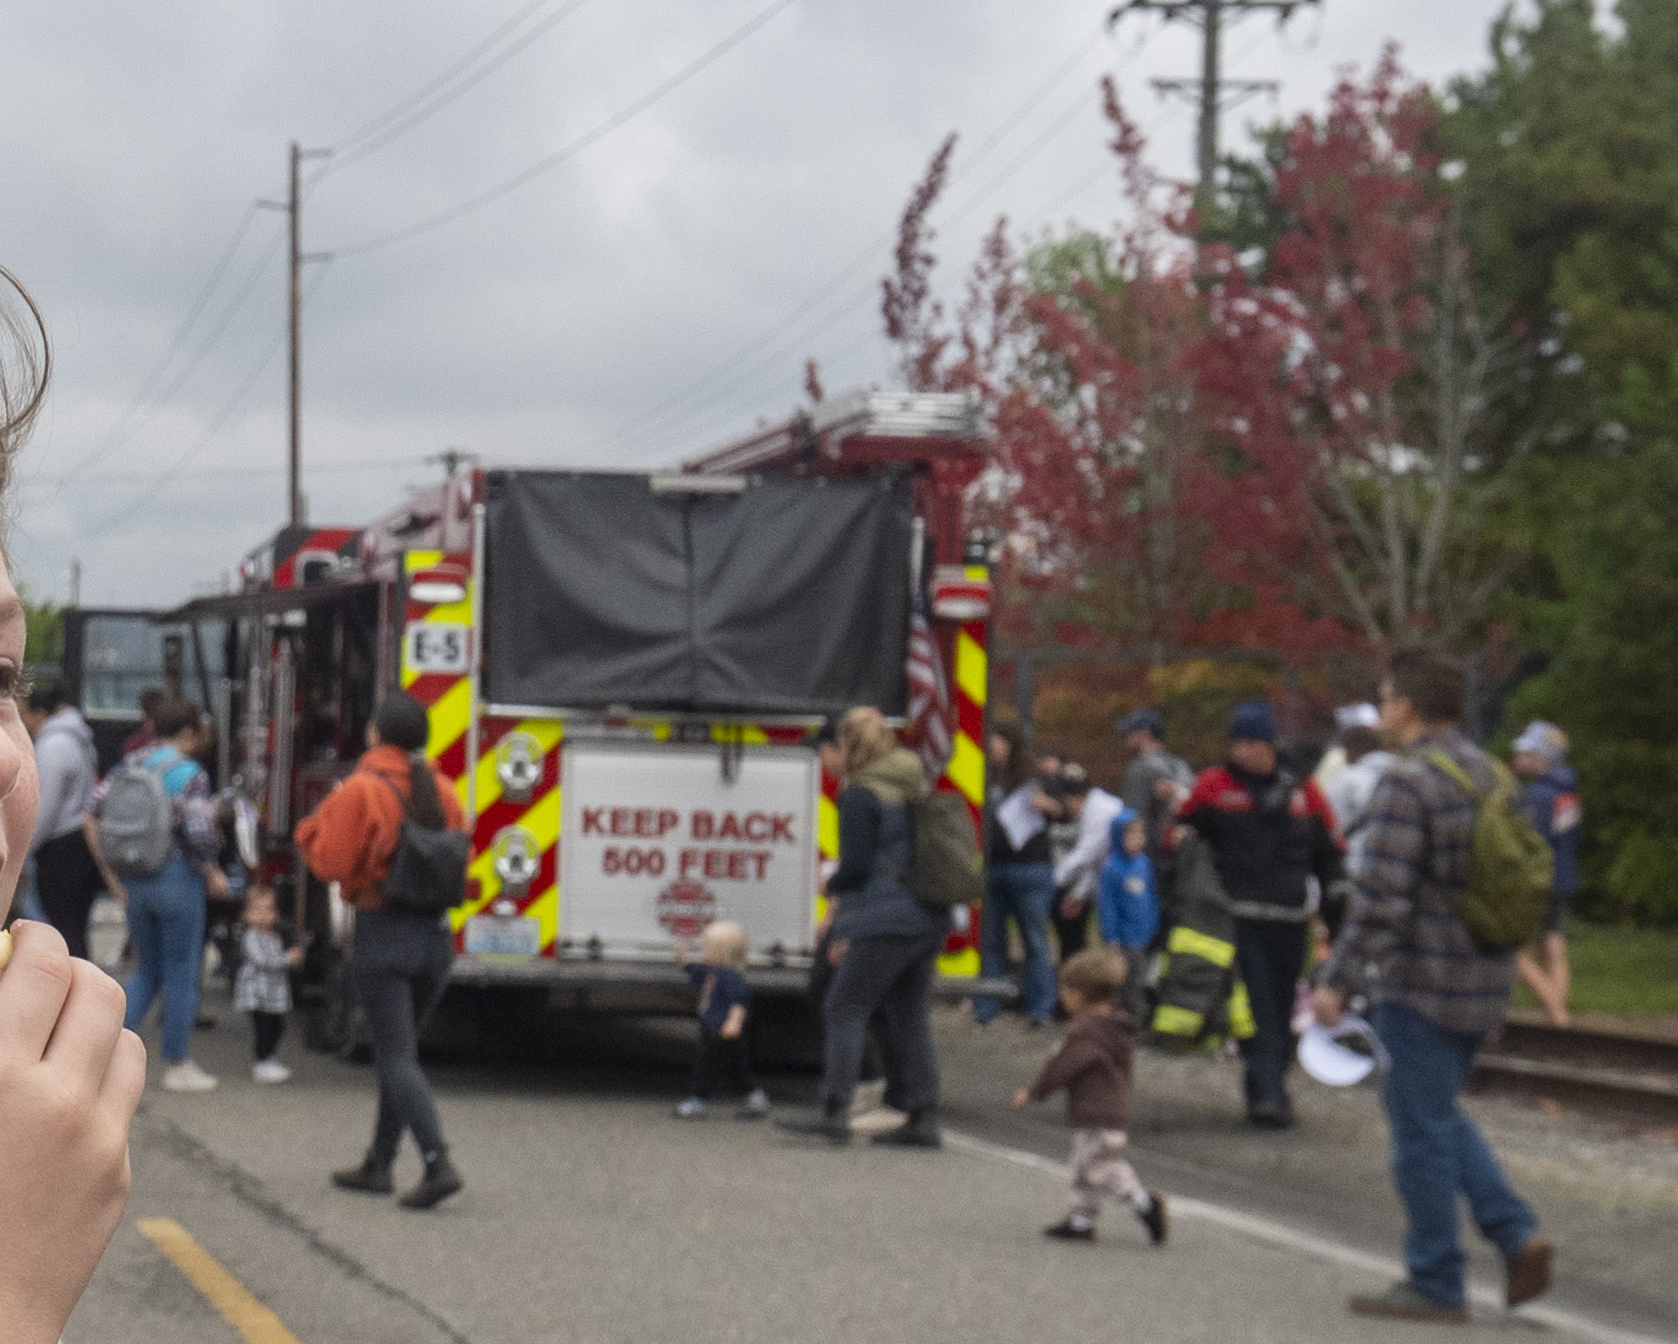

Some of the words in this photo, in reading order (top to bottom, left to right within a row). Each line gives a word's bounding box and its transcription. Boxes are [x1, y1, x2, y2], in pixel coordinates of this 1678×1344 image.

[415, 631, 460, 663] E-5
[582, 807, 680, 839] KEEP
[690, 811, 795, 844] BACK
[602, 847, 666, 877] 500
[679, 848, 774, 882] FEET
